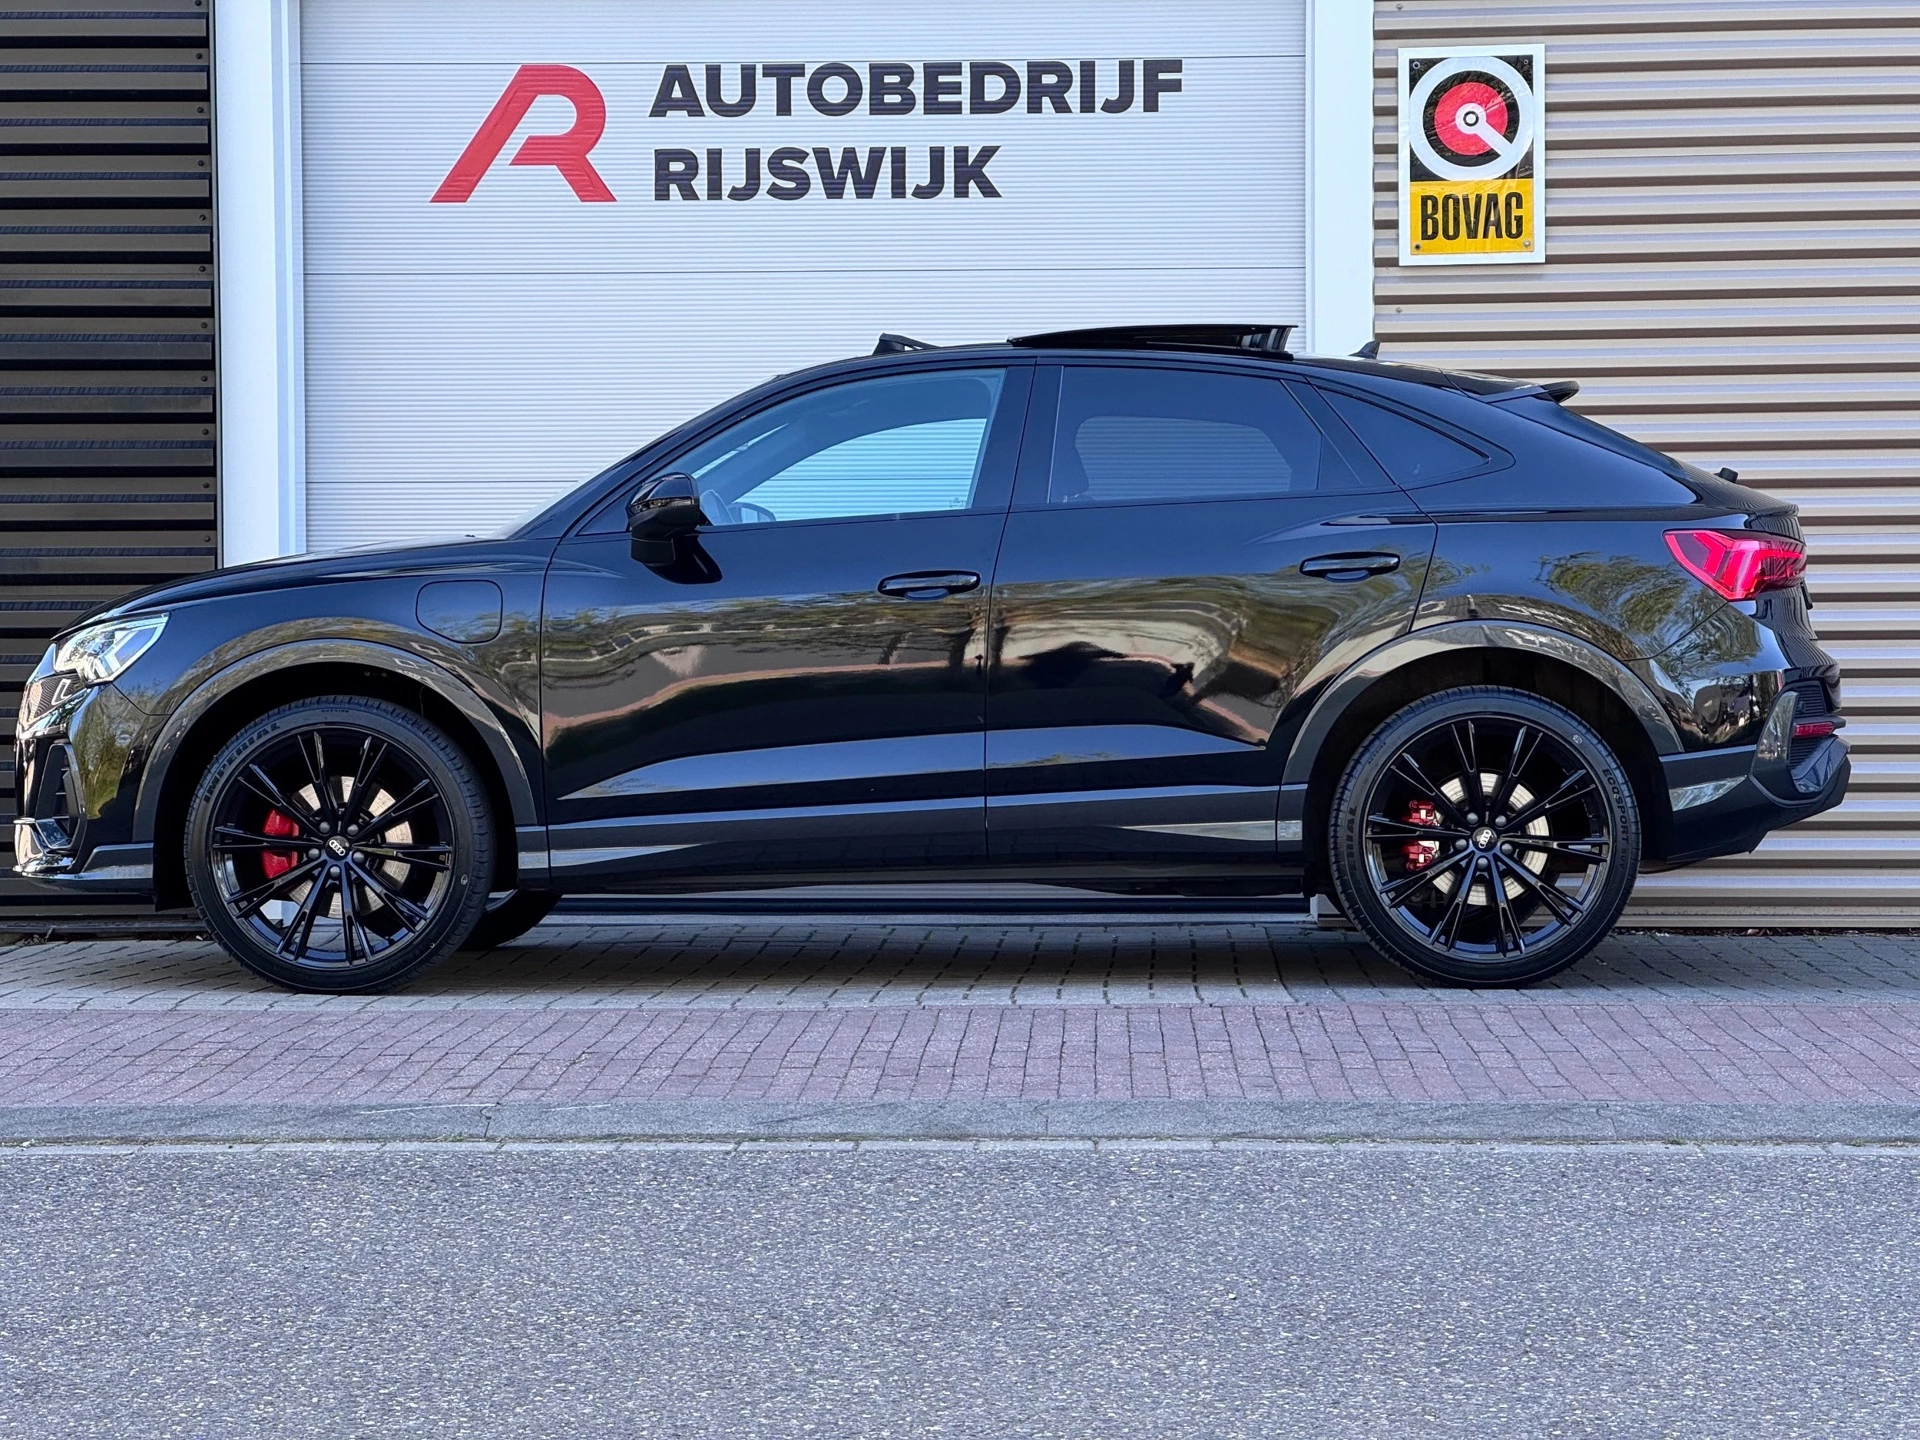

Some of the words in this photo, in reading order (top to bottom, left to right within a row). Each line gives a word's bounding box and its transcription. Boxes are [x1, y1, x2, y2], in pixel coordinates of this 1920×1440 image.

[648, 59, 1183, 117] AUTOBEDRIJF
[654, 145, 1003, 201] RIJSWIJK
[1420, 191, 1524, 241] BOVAG
[203, 722, 281, 803] IMPERIAL
[1602, 768, 1630, 844] ECOSPORT
